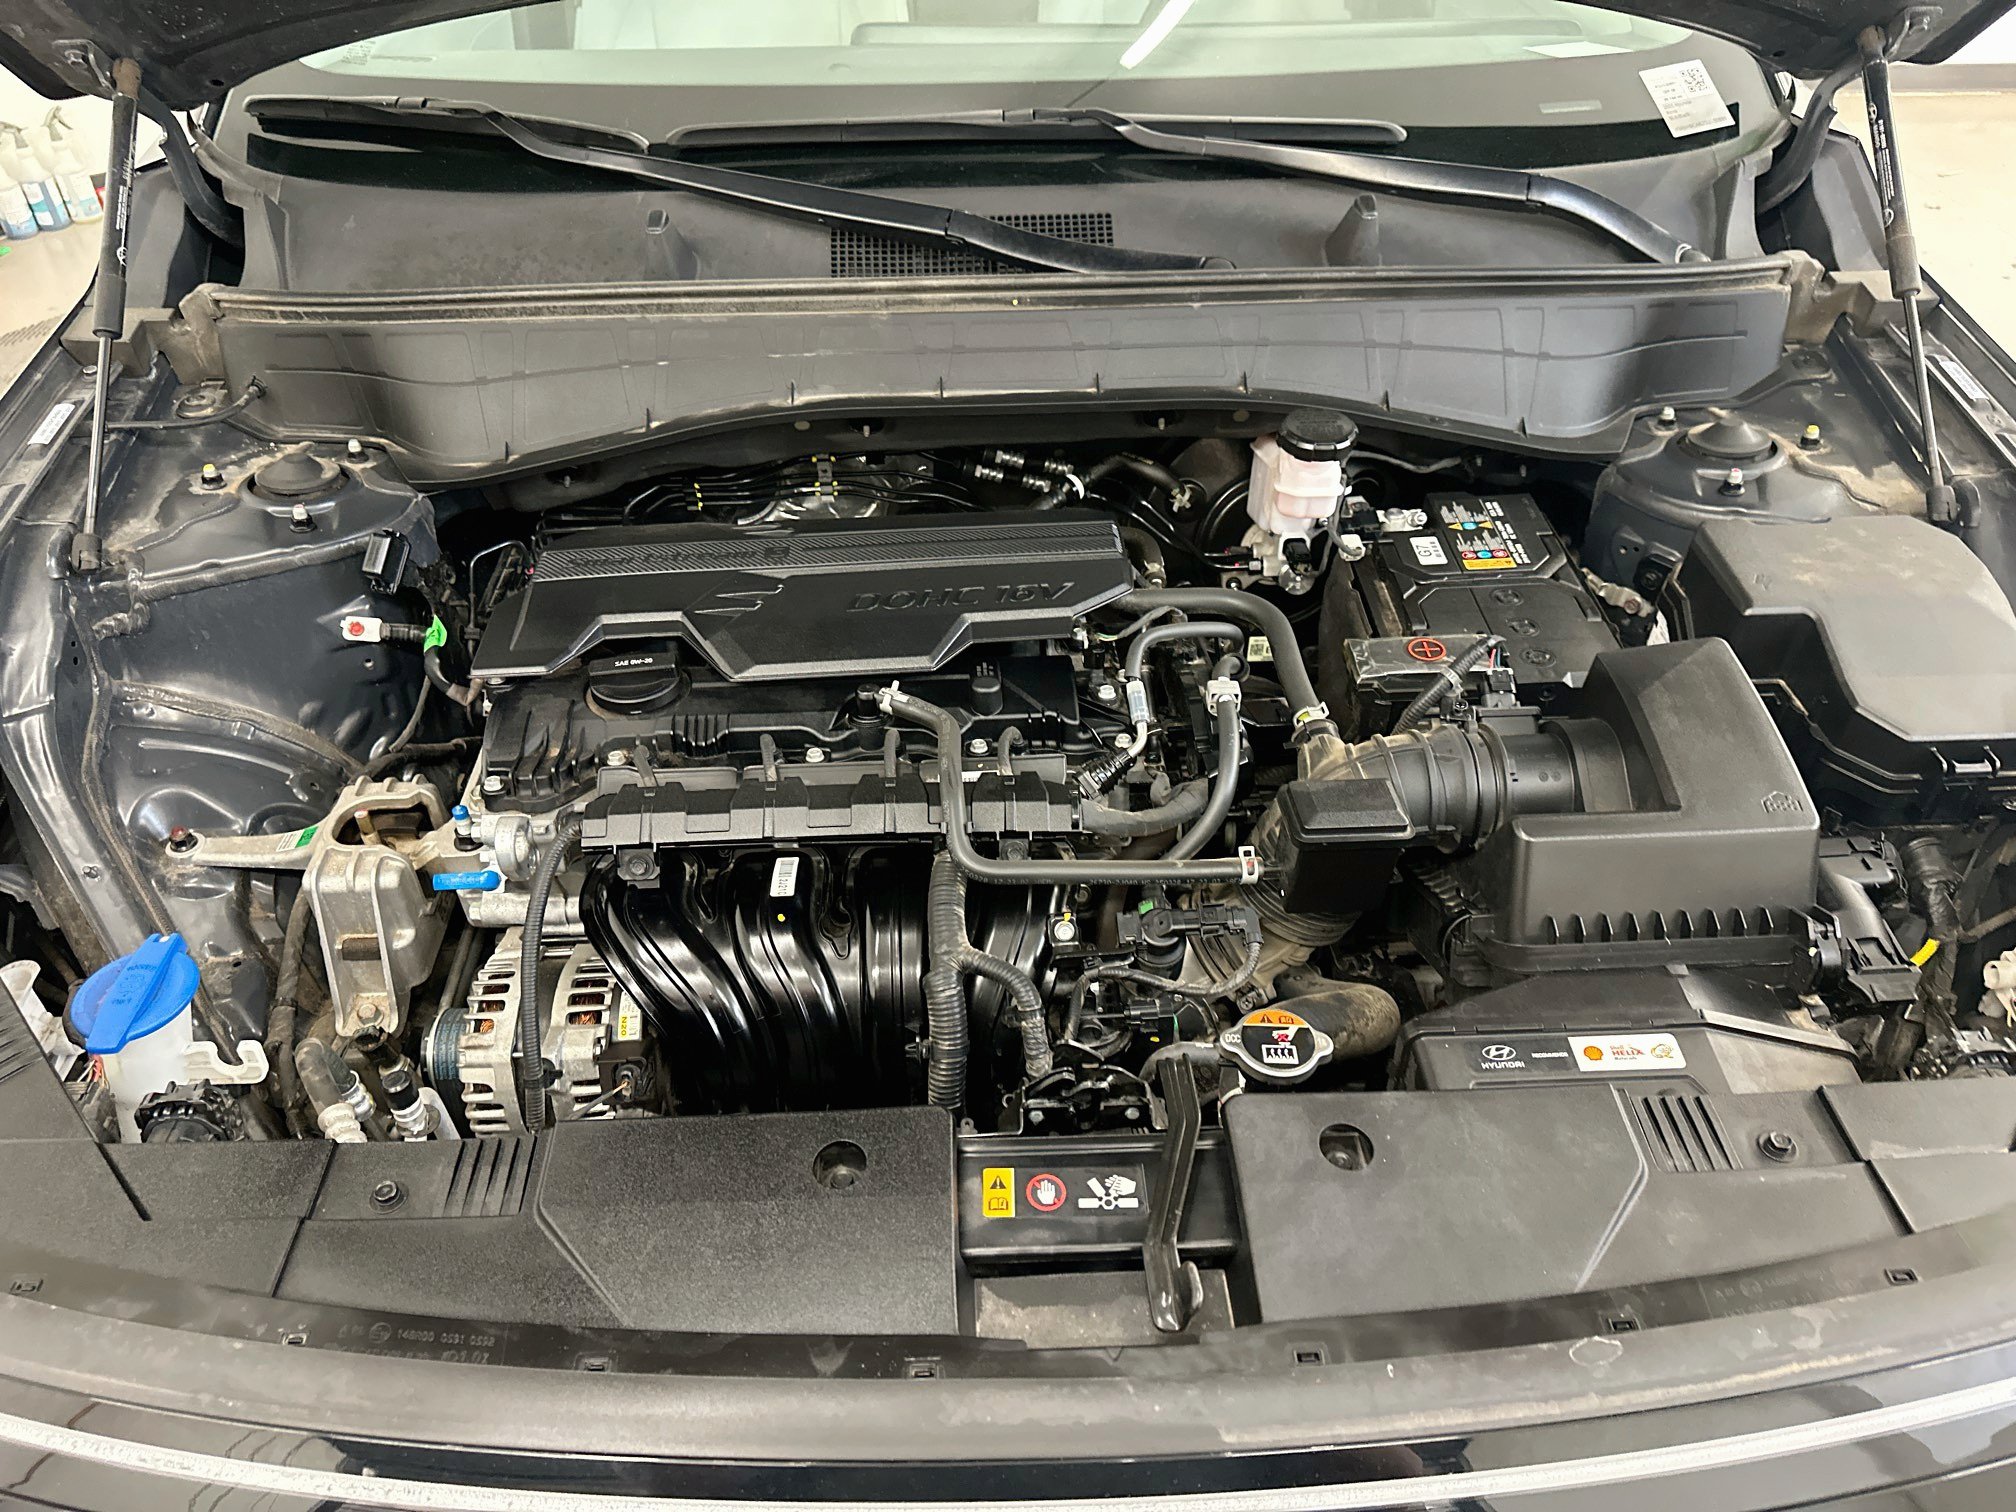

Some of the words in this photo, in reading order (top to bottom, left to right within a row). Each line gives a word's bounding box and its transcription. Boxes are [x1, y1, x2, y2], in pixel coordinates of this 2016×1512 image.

[1416, 545, 1431, 557] G7
[846, 586, 986, 612] DOHC
[994, 580, 1076, 605] 16V
[614, 659, 629, 667] SAE
[630, 657, 653, 665] 0W-20
[1225, 1033, 1241, 1043] DCC
[1611, 1047, 1646, 1056] HELIX
[1480, 1060, 1526, 1070] HYUNDAI
